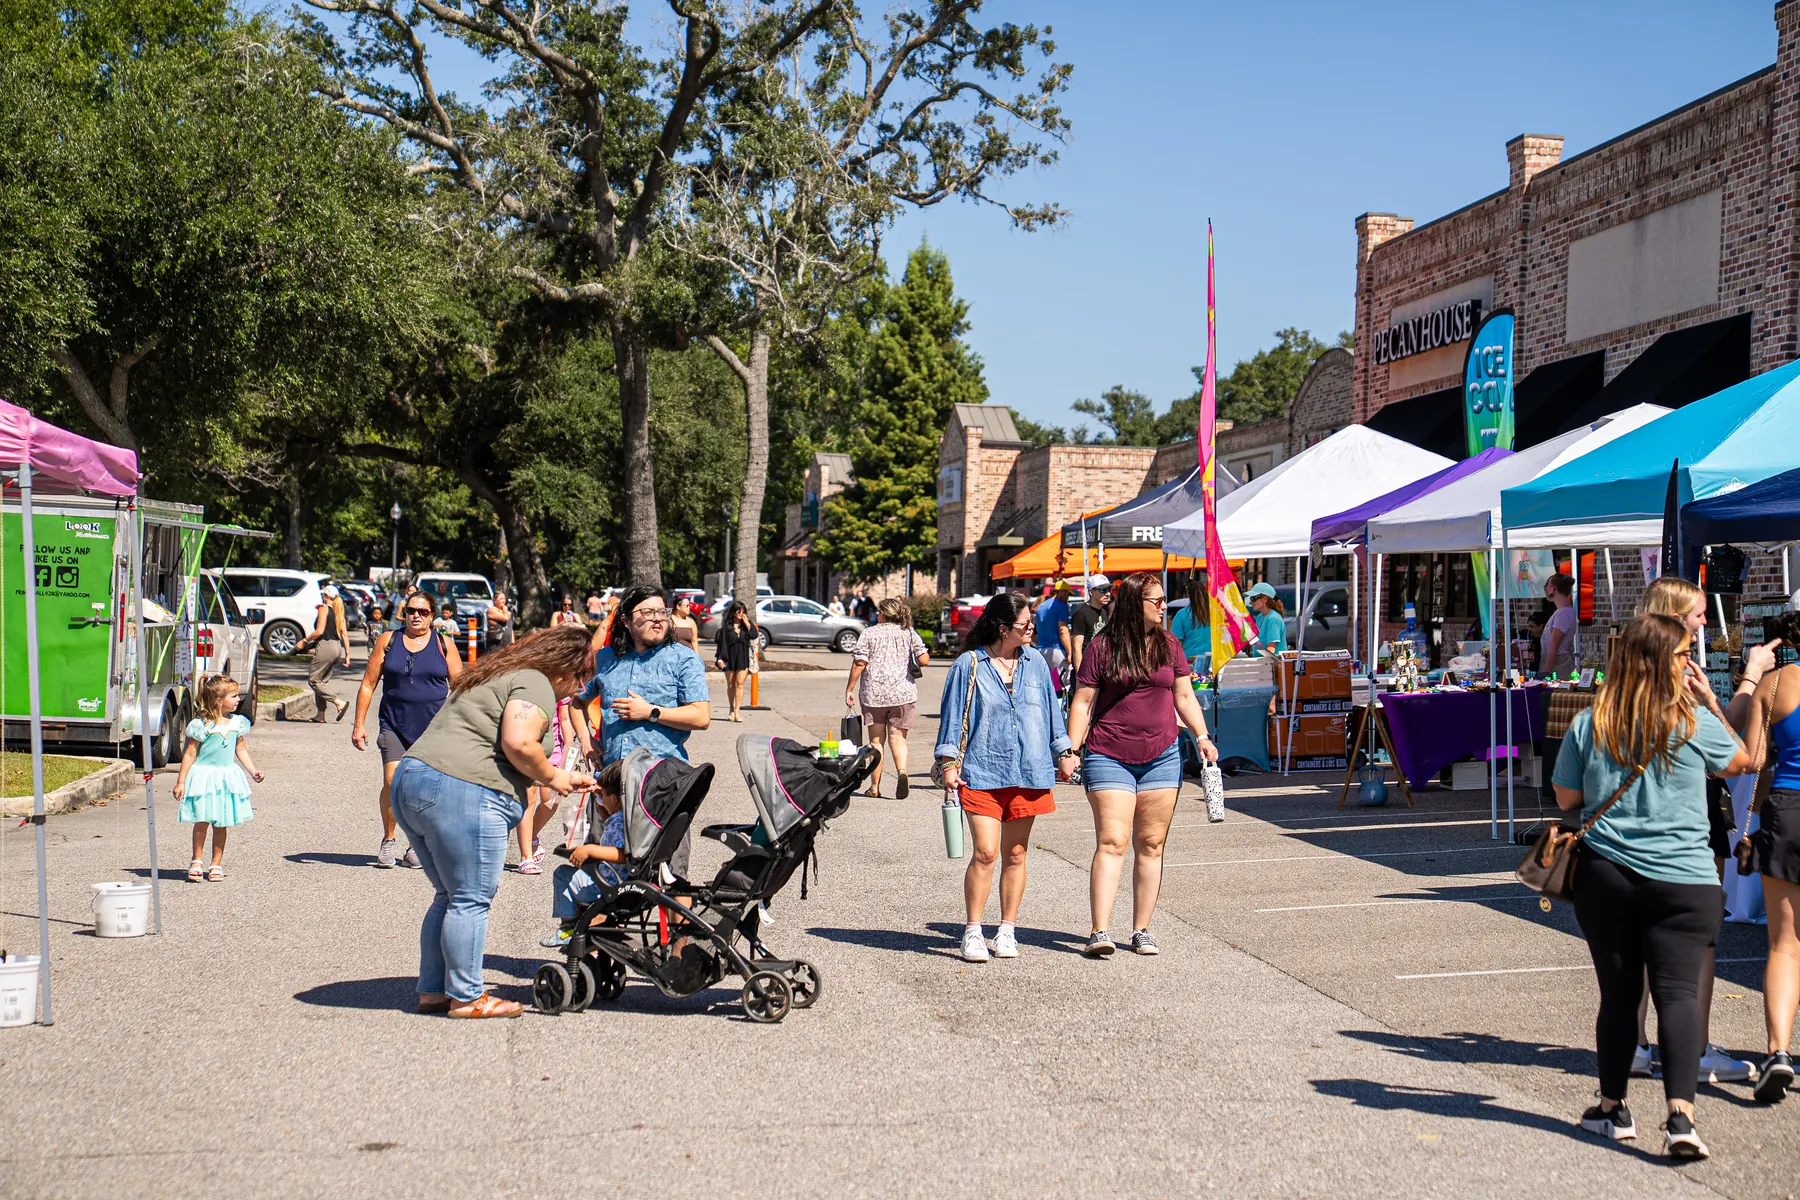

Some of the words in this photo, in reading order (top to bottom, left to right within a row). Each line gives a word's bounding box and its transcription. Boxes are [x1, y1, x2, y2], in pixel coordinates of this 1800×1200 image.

[1474, 345, 1507, 379] ICE
[65, 520, 100, 532] LOOK
[19, 544, 56, 553] FLOW
[59, 546, 71, 554] US
[74, 546, 91, 555] AND
[33, 555, 48, 563] IKE
[51, 556, 63, 564] US
[66, 557, 79, 565] ON
[1303, 702, 1328, 712] CONTAINERS
[1328, 702, 1332, 711] &
[1332, 702, 1341, 711] LIDS
[1297, 759, 1321, 769] CONTAINERS
[1321, 759, 1326, 768] &
